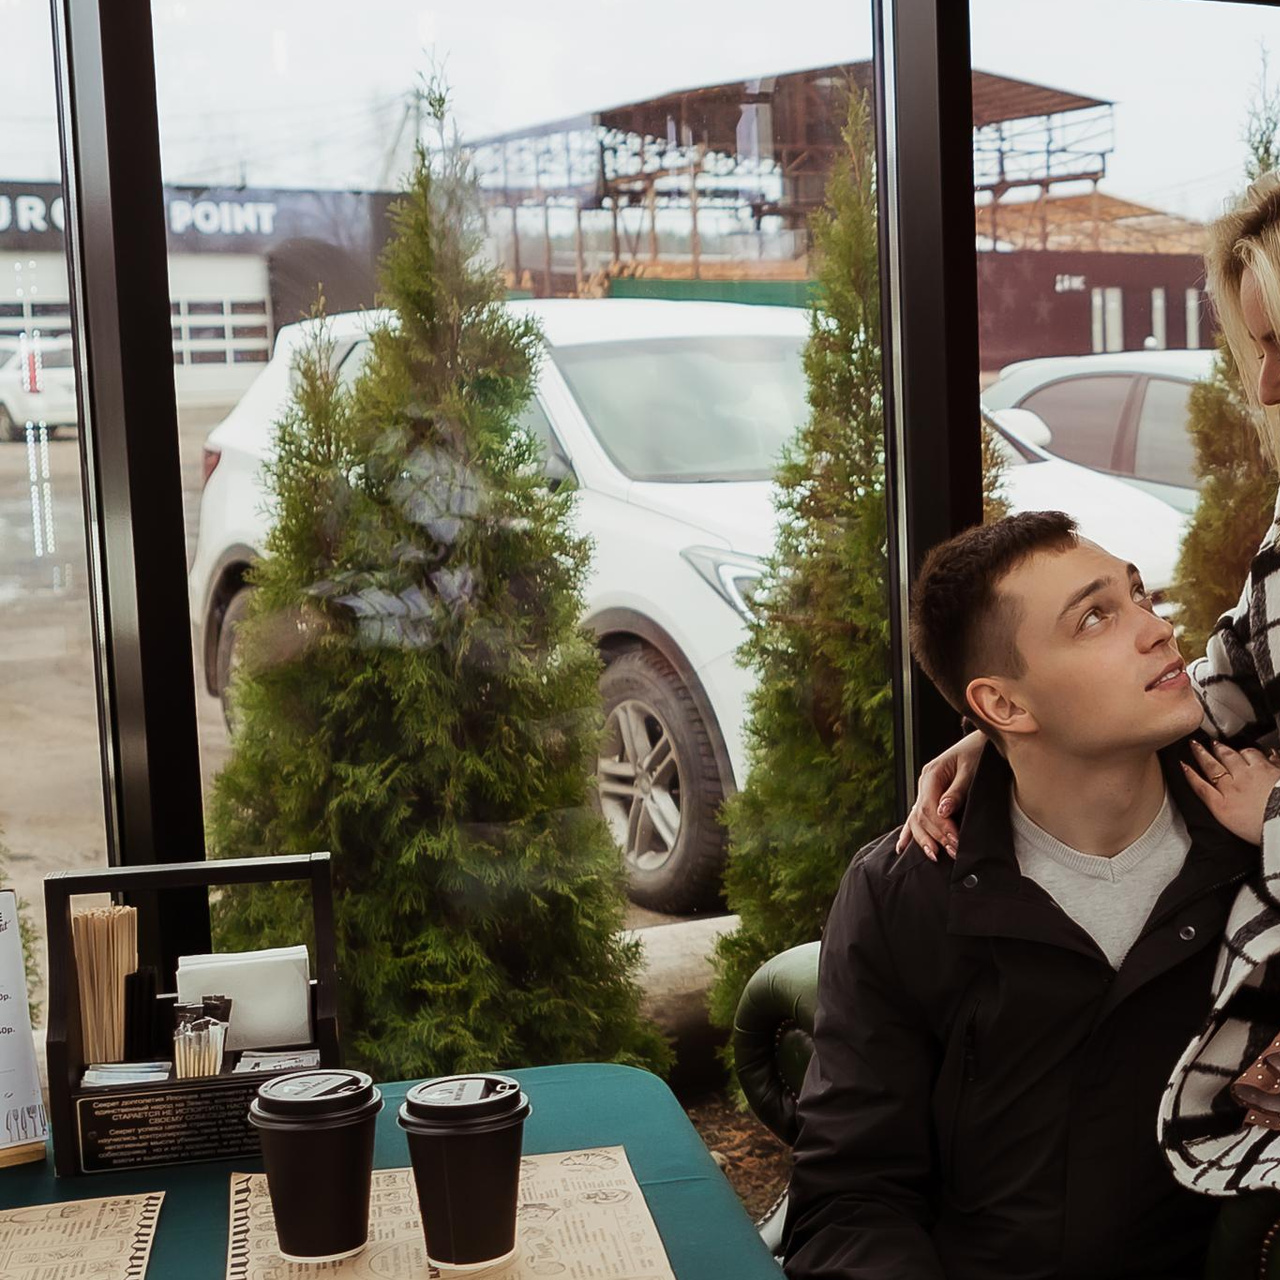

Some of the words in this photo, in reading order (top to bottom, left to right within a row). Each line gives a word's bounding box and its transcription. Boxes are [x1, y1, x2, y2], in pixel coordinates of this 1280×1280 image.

[168, 200, 278, 235] POINT
[112, 1111, 161, 1121] СТАРАЕТСЯ
[162, 1109, 174, 1117] НЕ
[148, 1114, 184, 1124] СВОЕМУ
